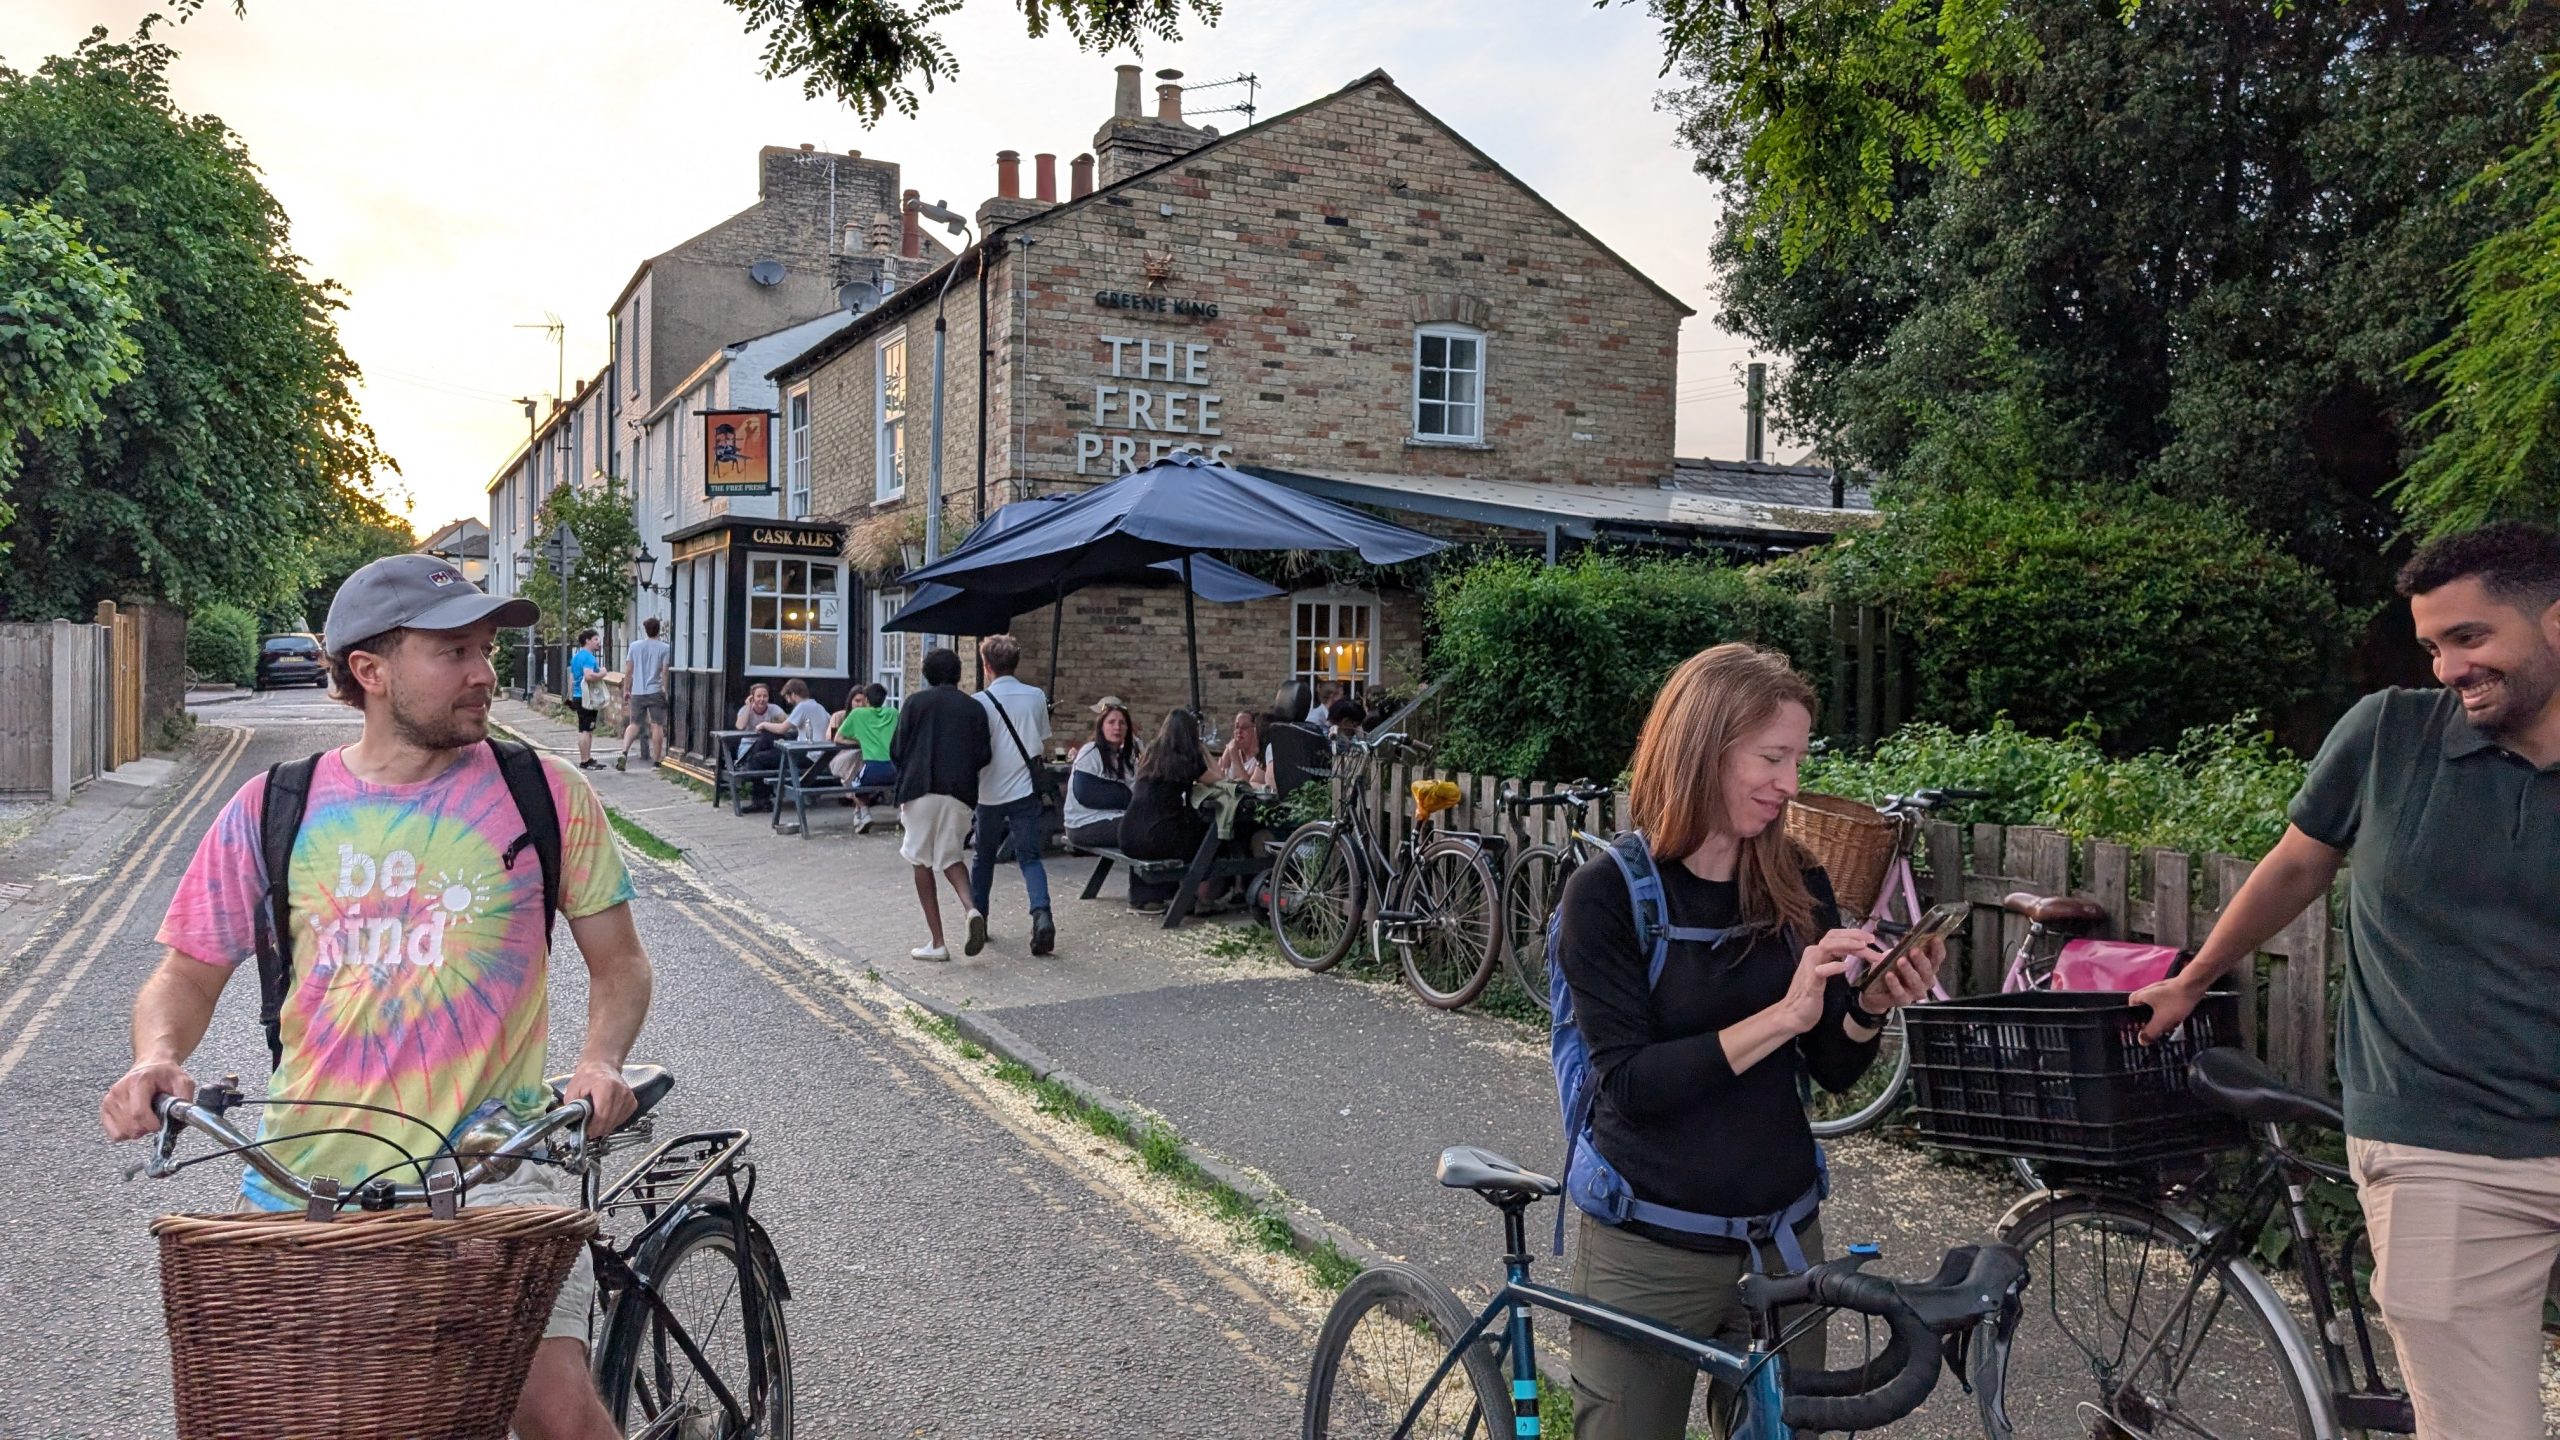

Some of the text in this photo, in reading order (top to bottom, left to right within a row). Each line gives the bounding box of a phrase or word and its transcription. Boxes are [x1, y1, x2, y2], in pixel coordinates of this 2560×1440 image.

[1095, 291, 1219, 318] GREENE KING
[1100, 335, 1209, 385] THE
[1095, 385, 1222, 436] FREE
[1076, 433, 1233, 476] PRES
[711, 484, 724, 492] THE
[725, 484, 743, 492] FREE
[753, 528, 834, 548] CASK ALES
[335, 843, 417, 897] be
[309, 903, 447, 967] kind
